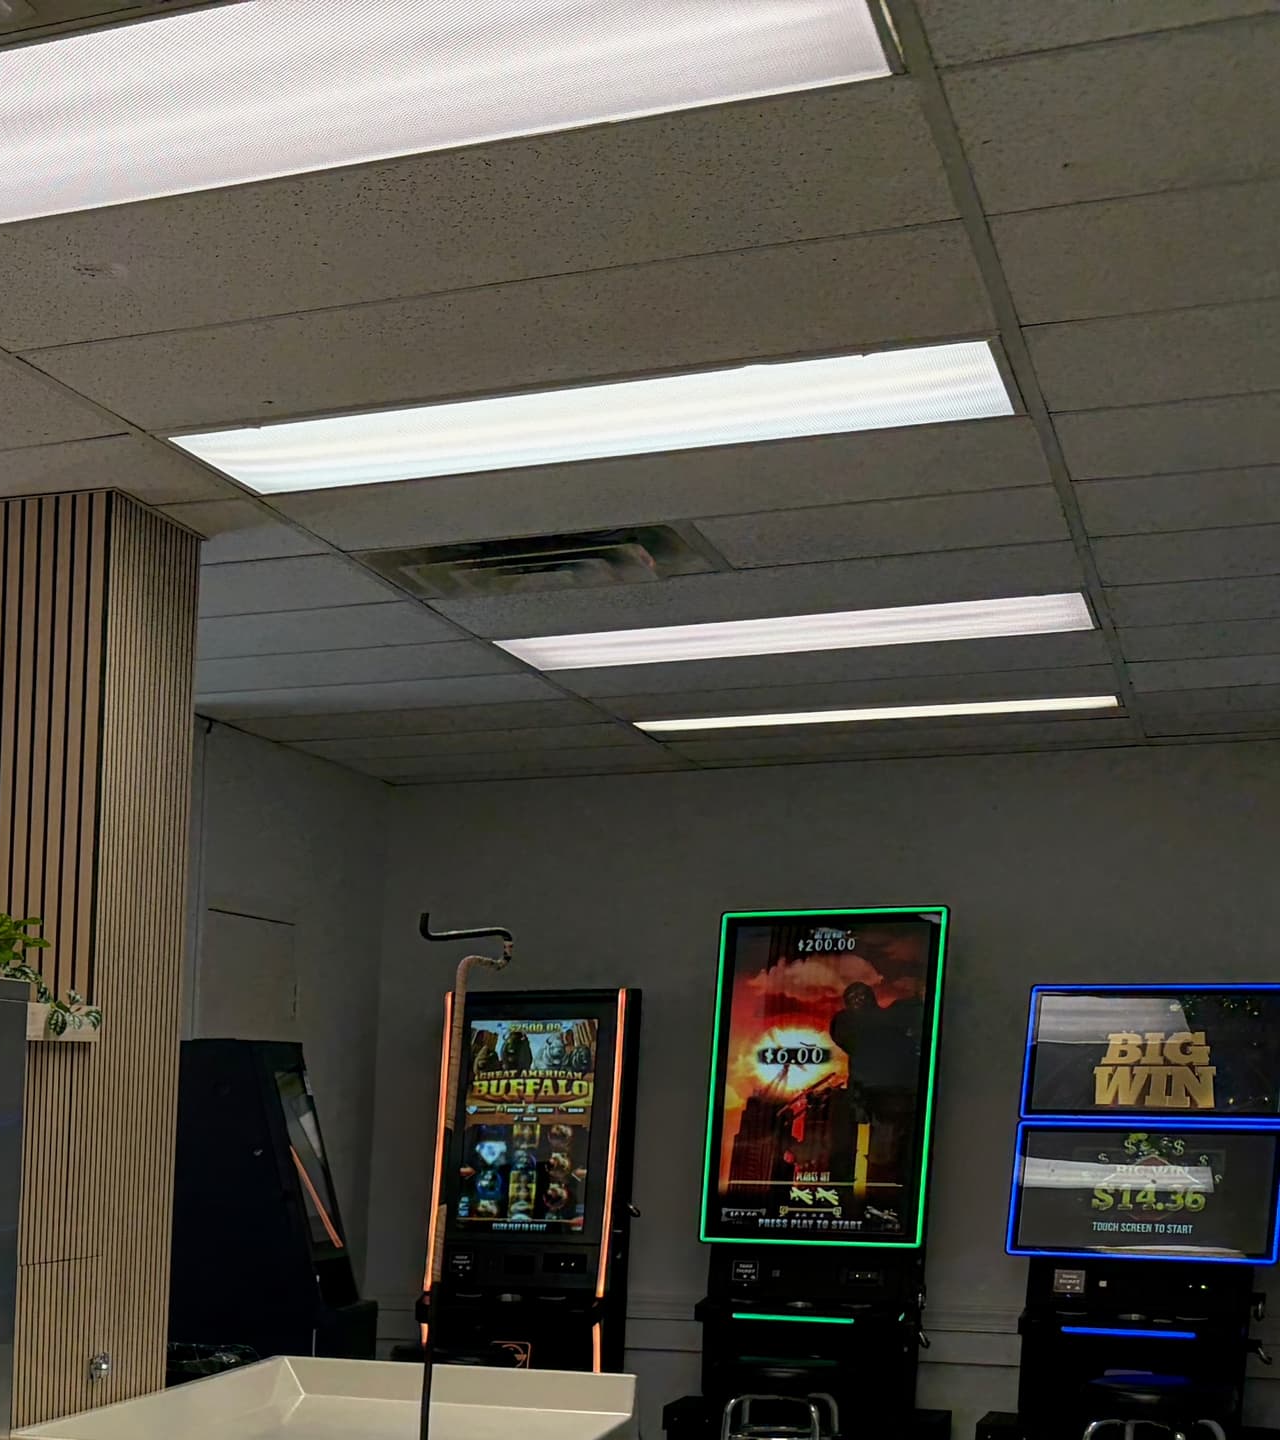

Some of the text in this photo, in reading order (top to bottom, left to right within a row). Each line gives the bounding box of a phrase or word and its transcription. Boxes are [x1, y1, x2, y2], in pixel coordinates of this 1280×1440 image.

[798, 938, 856, 952] $200.00
[765, 1047, 824, 1064] $6.00
[1101, 1031, 1211, 1065] BIG
[520, 1069, 583, 1080] AMERICAN
[473, 1079, 590, 1097] BUFFALO
[1094, 1066, 1217, 1109] WIN
[1092, 1182, 1207, 1212] $14.36
[758, 1218, 863, 1230] PRESS PLAY TO START
[1093, 1222, 1193, 1234] TOUCH SCREEN TO START
